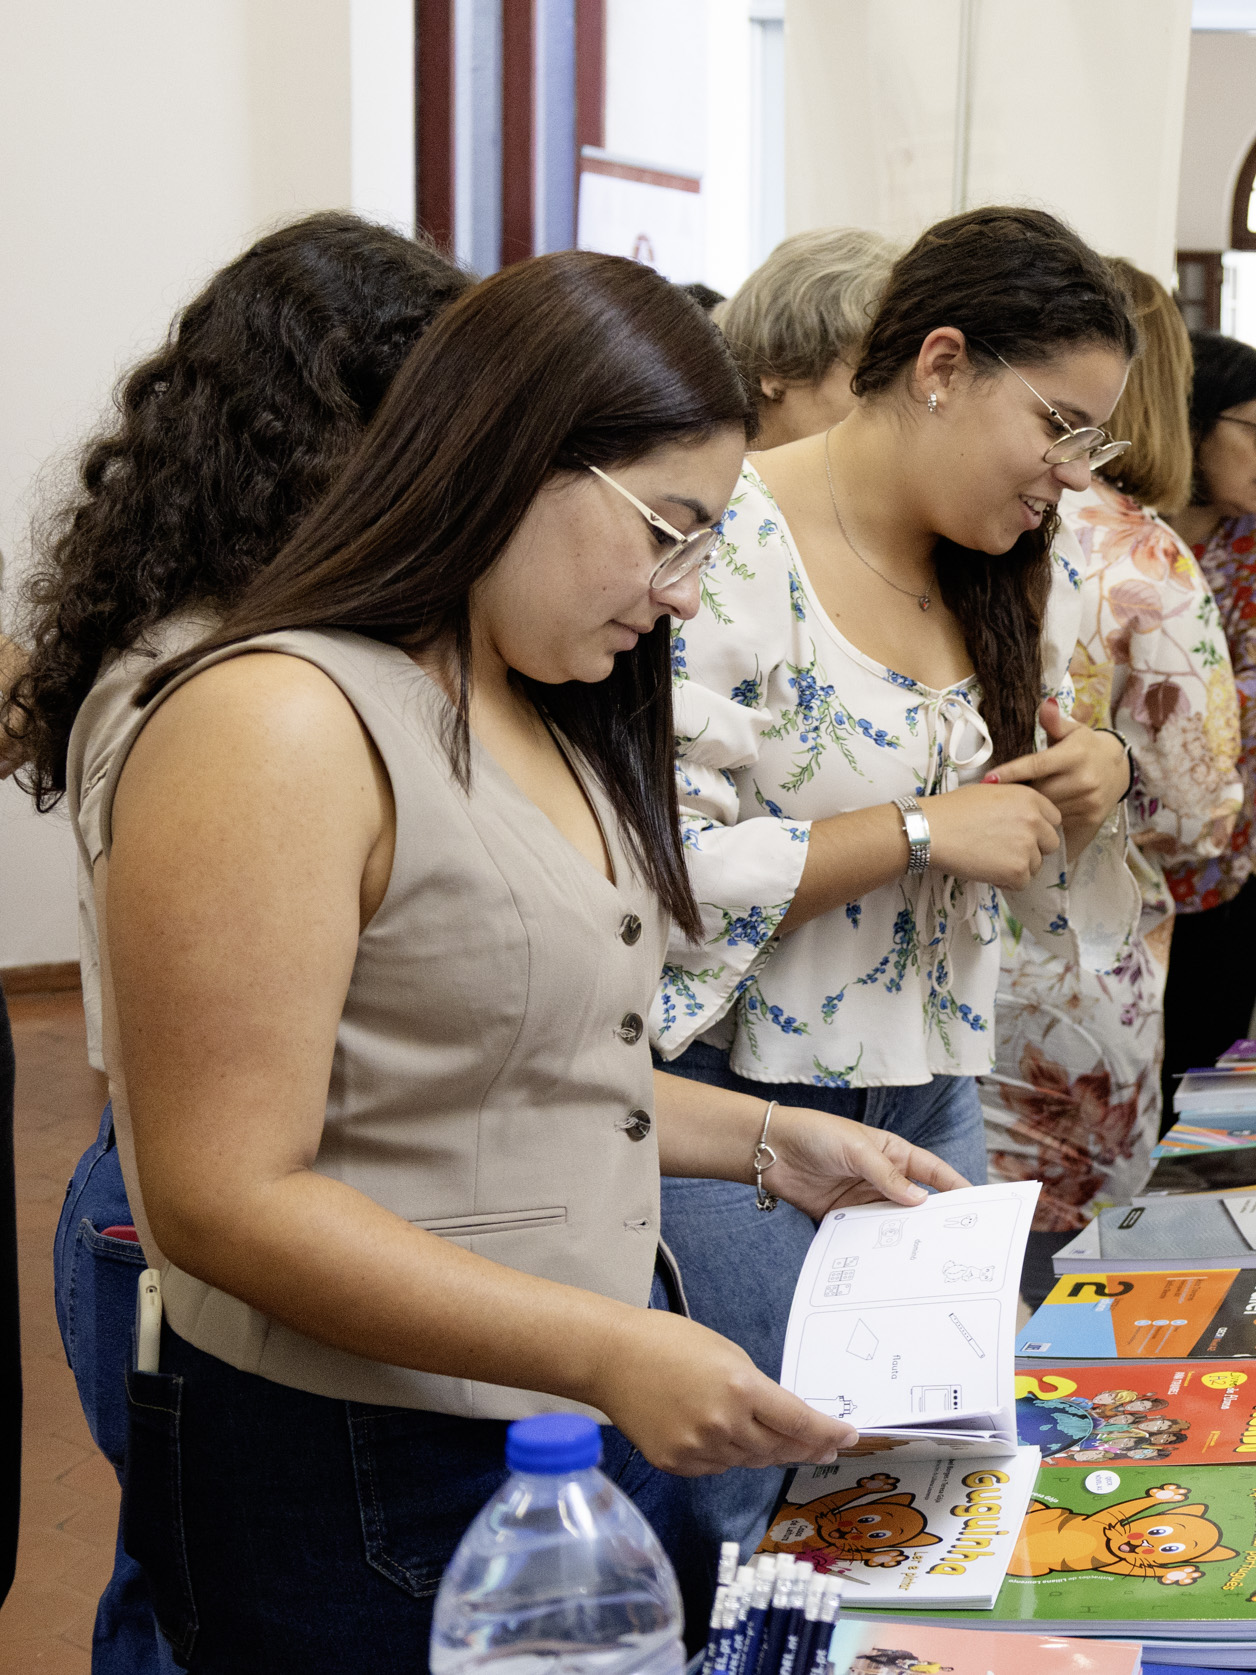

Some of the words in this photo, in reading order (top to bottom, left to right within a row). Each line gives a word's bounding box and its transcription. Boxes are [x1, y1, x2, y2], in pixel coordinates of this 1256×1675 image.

[1067, 1281, 1134, 1297] 2
[891, 1355, 900, 1380] flauta
[1209, 1376, 1228, 1385] A2
[926, 1470, 1010, 1576] Guguinha
[913, 1551, 928, 1563] Ler
[898, 1572, 915, 1591] pintar
